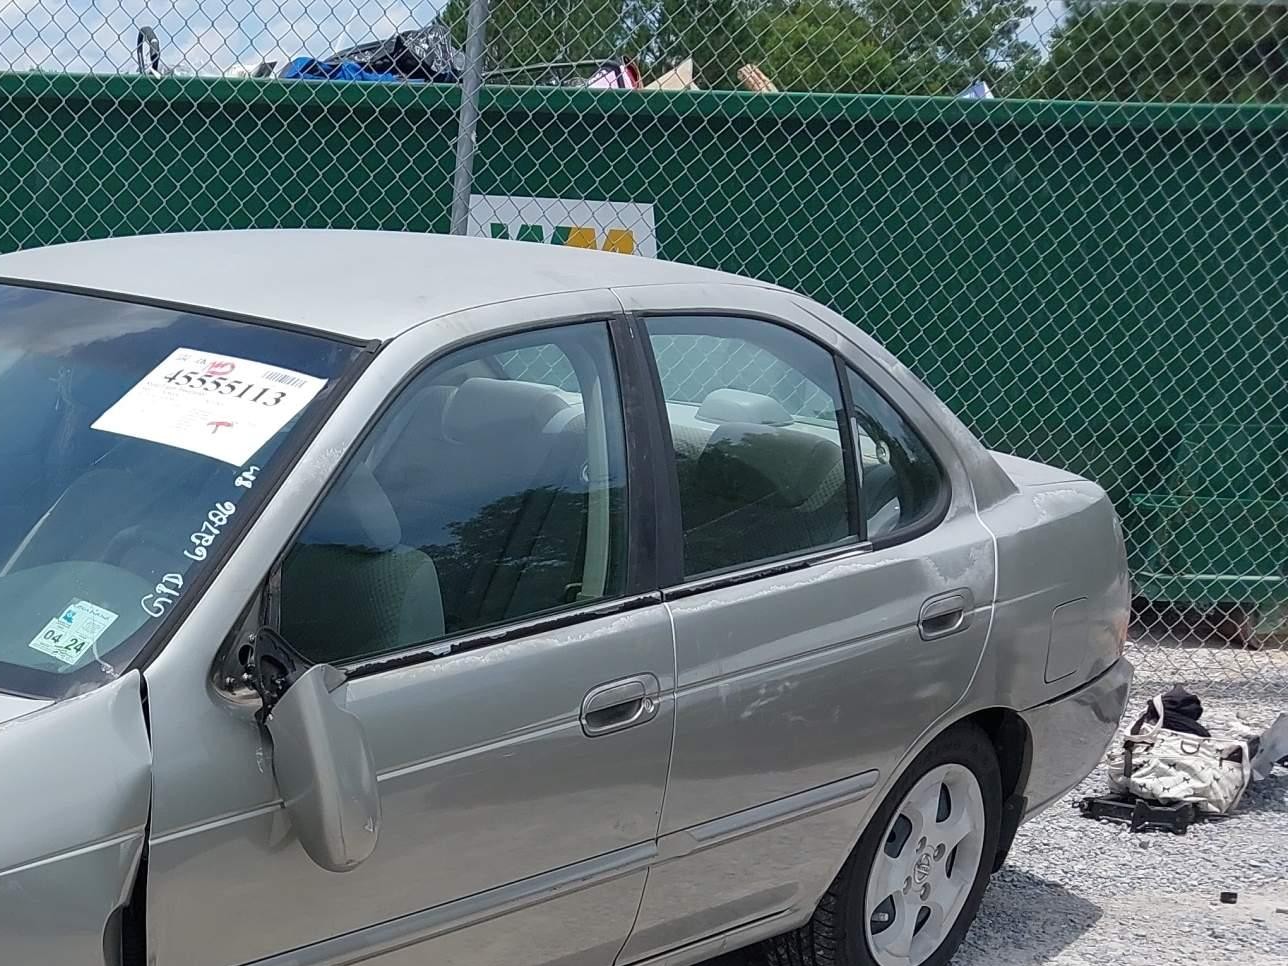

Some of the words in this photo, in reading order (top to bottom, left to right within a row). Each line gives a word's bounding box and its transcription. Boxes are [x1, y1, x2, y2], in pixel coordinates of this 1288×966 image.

[164, 369, 287, 407] 45555113
[43, 630, 63, 643] 04
[64, 638, 86, 653] 24
